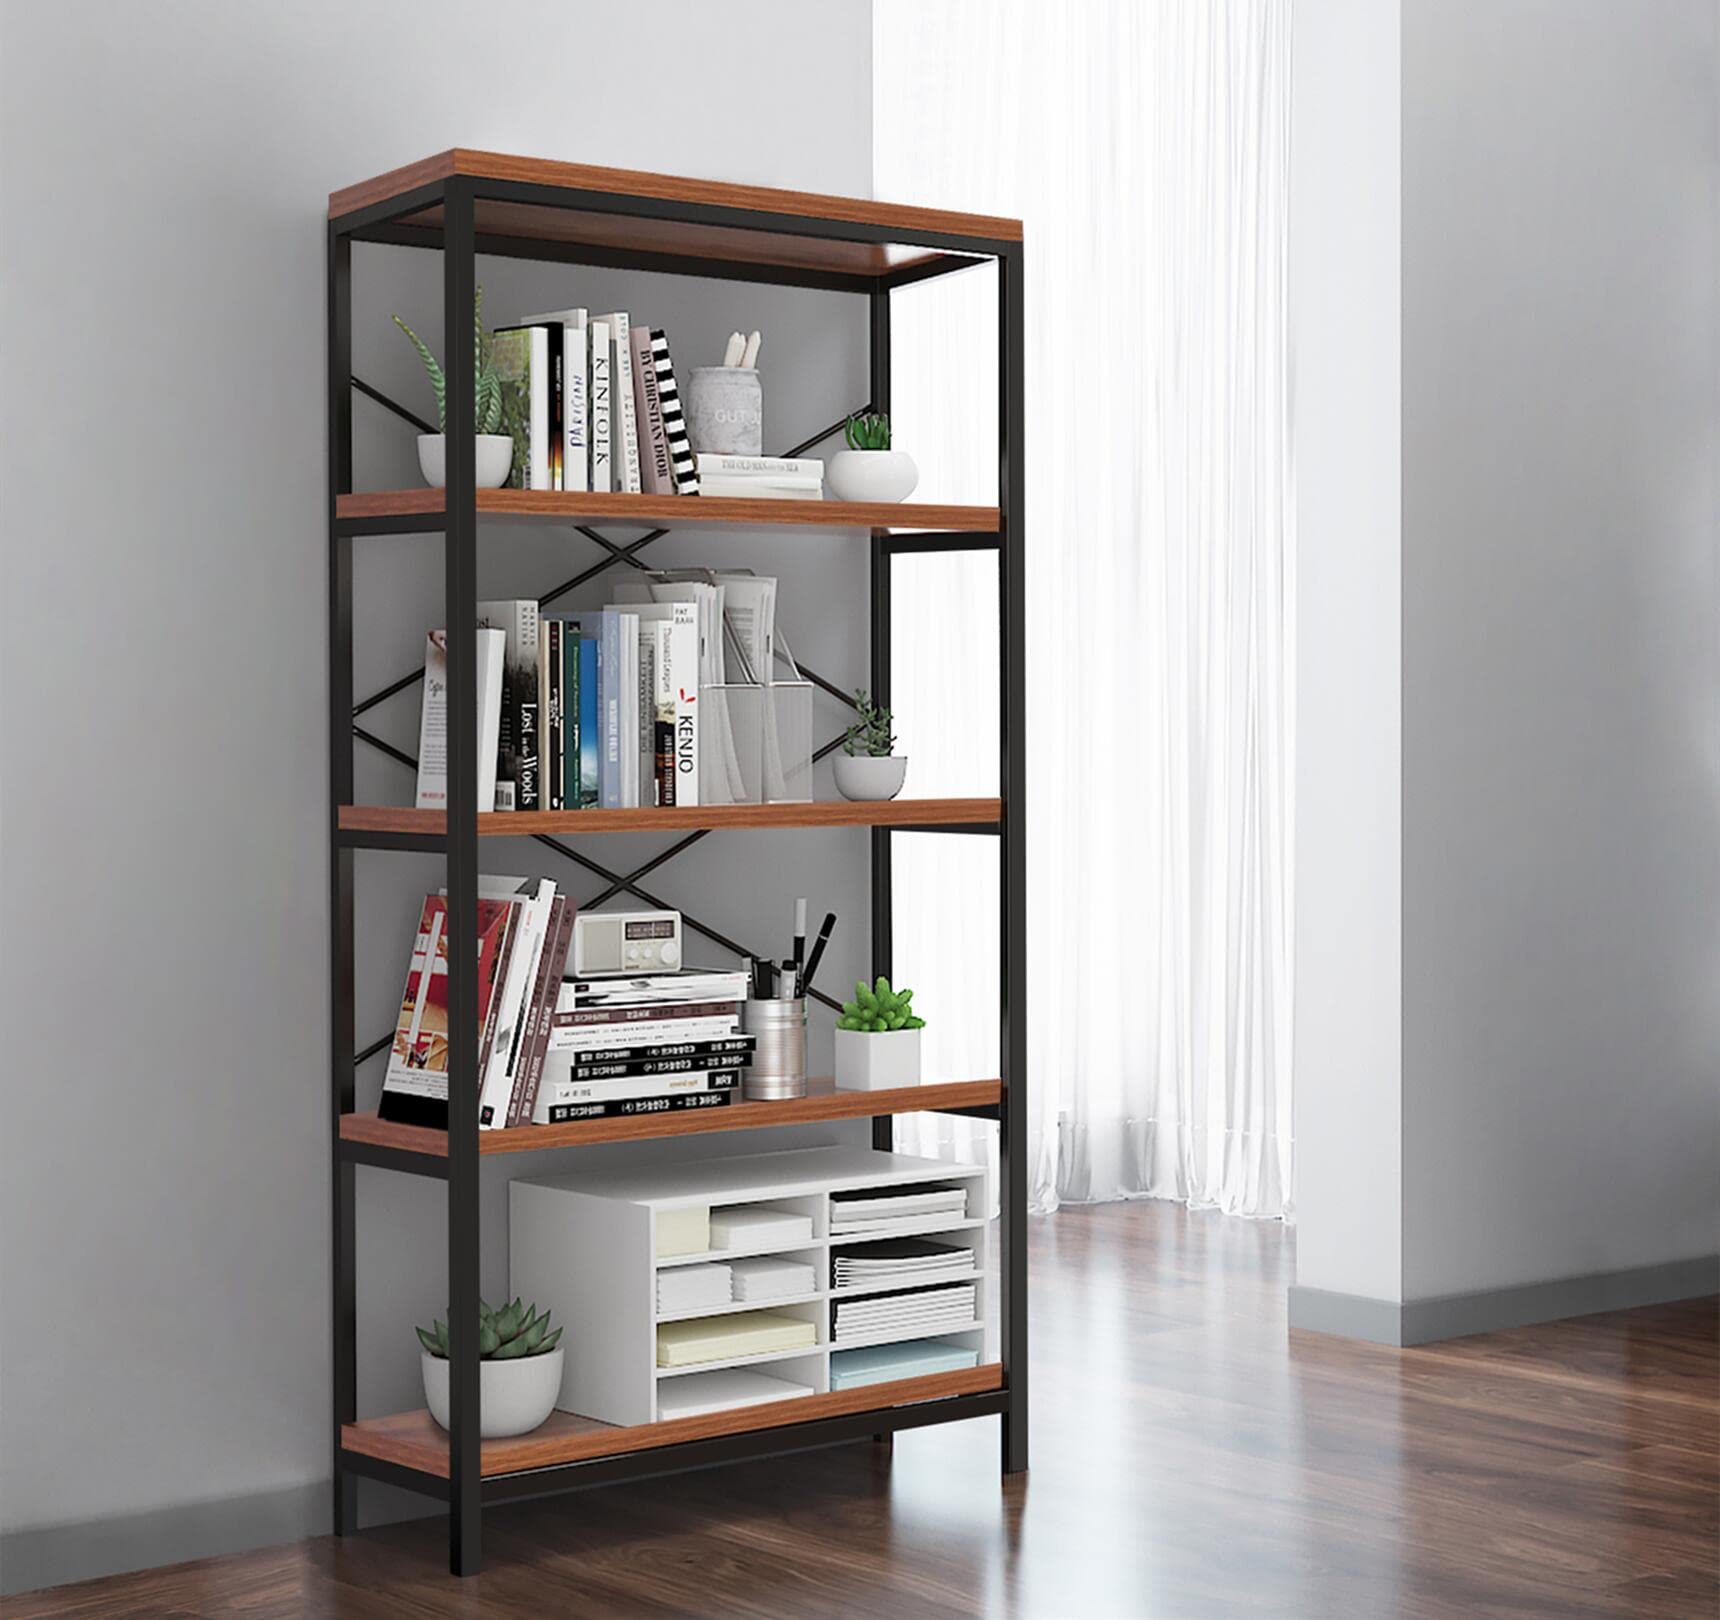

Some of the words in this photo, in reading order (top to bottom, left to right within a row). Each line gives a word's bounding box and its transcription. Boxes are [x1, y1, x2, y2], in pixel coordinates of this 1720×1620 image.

[639, 349, 654, 370] BY
[595, 357, 609, 465] KINFOLK
[643, 370, 664, 441] CHRISTIAN
[653, 444, 669, 478] DIOR
[521, 702, 537, 733] Lost
[678, 715, 694, 774] KENJO
[521, 756, 538, 805] Woods
